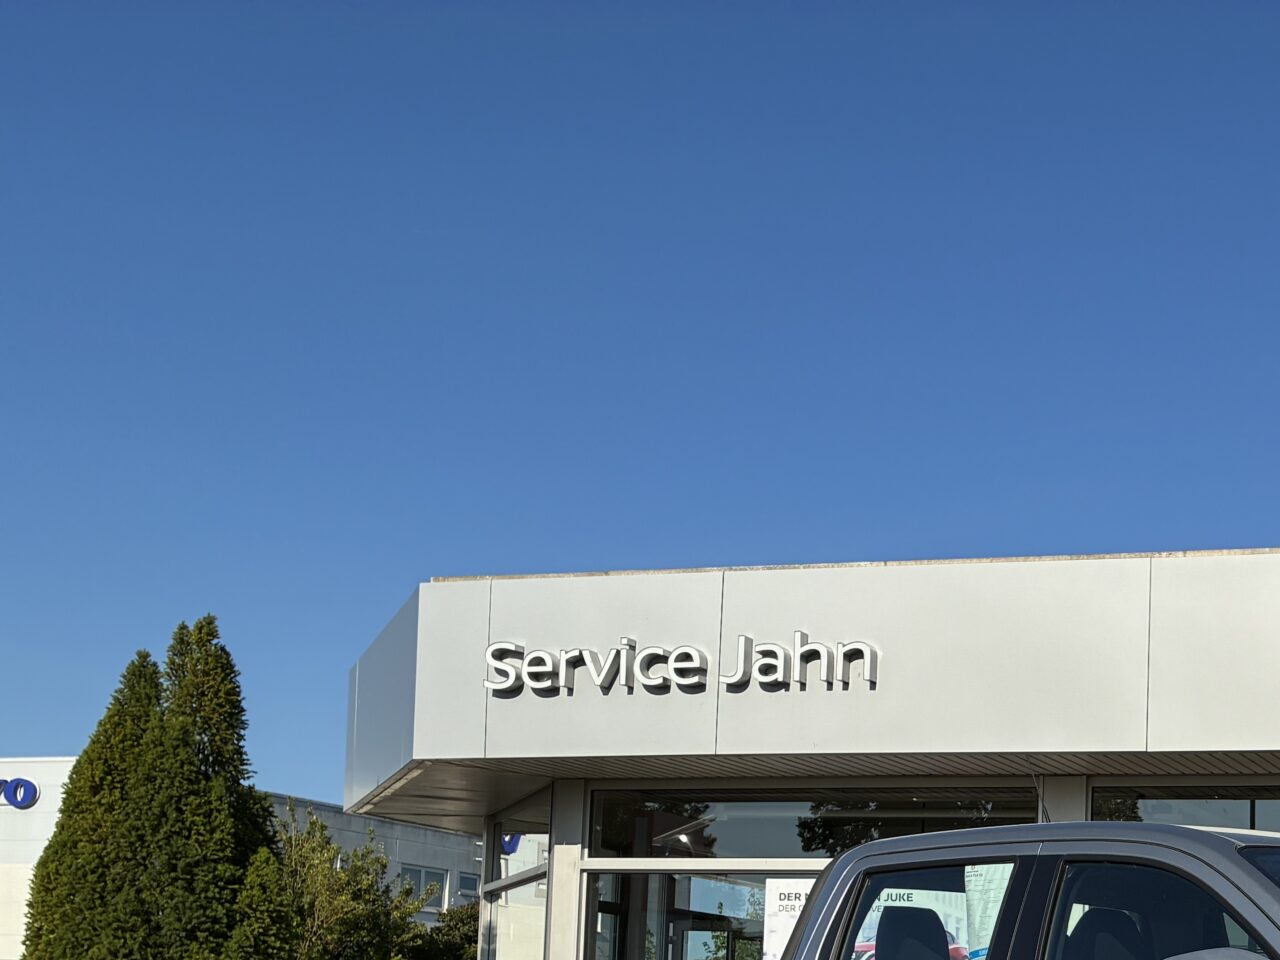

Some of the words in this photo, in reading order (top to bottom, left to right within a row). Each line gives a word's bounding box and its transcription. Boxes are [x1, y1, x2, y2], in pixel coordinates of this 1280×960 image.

[483, 637, 707, 696] Service
[719, 630, 878, 691] Jahn
[779, 892, 802, 901] DER
[884, 892, 914, 902] JUKE
[778, 904, 797, 913] DER
